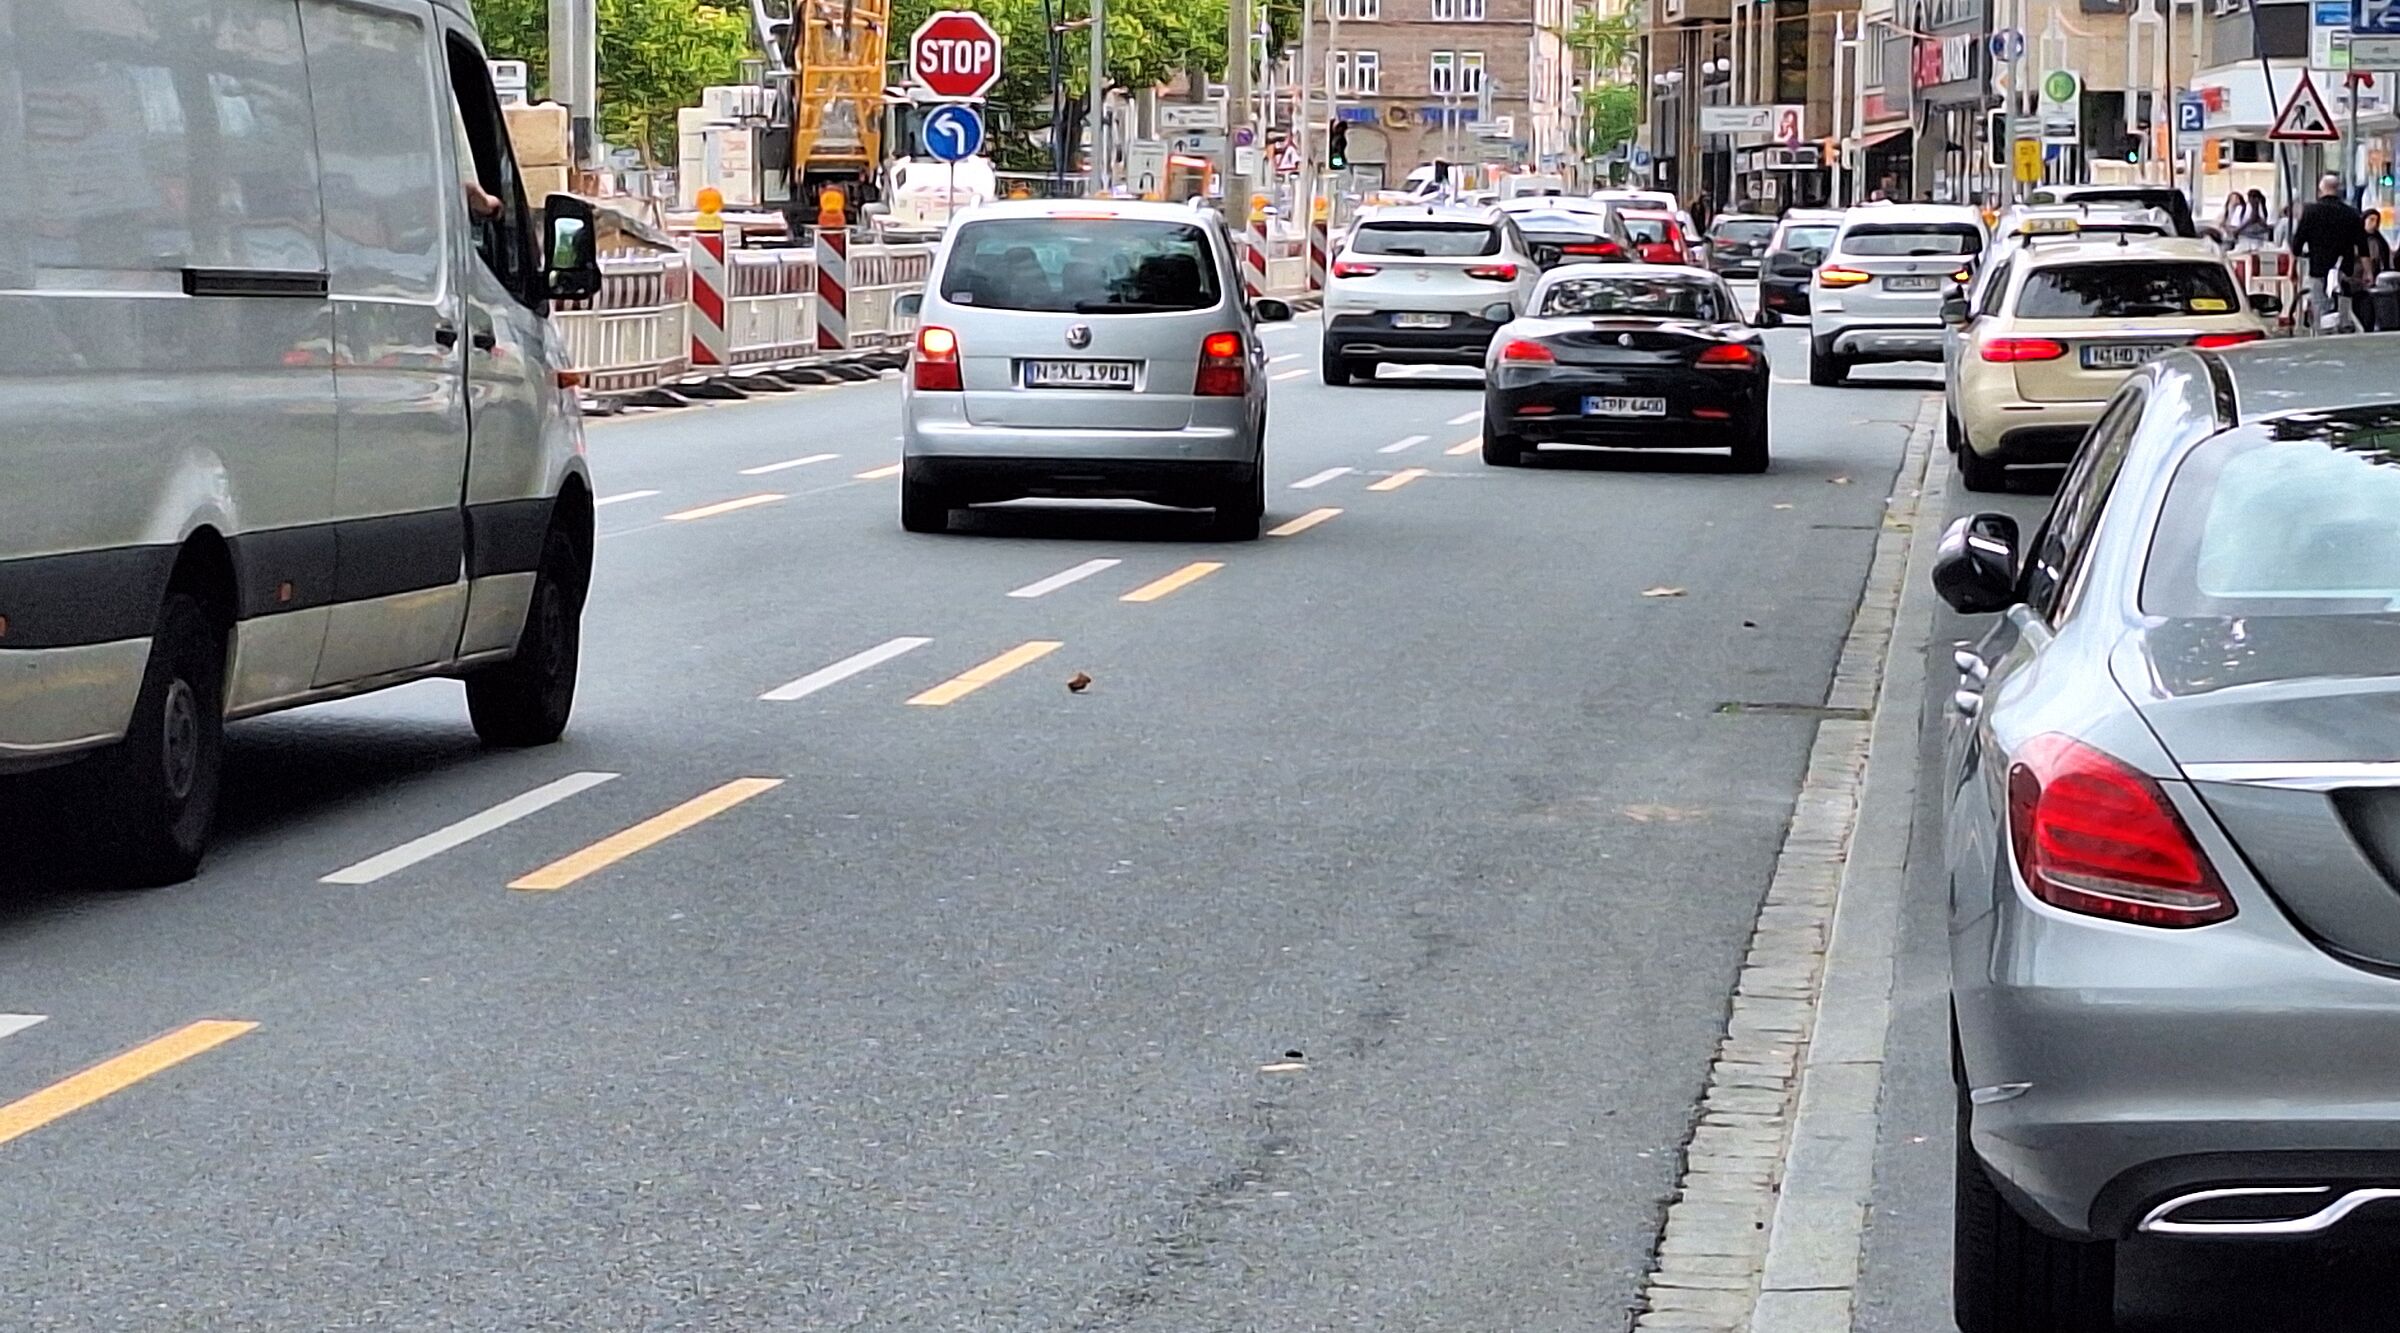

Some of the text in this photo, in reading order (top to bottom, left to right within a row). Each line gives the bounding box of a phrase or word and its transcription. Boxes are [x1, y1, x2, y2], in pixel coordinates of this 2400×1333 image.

[920, 39, 991, 74] STOP
[1036, 363, 1048, 379] N
[1060, 363, 1083, 379] XL
